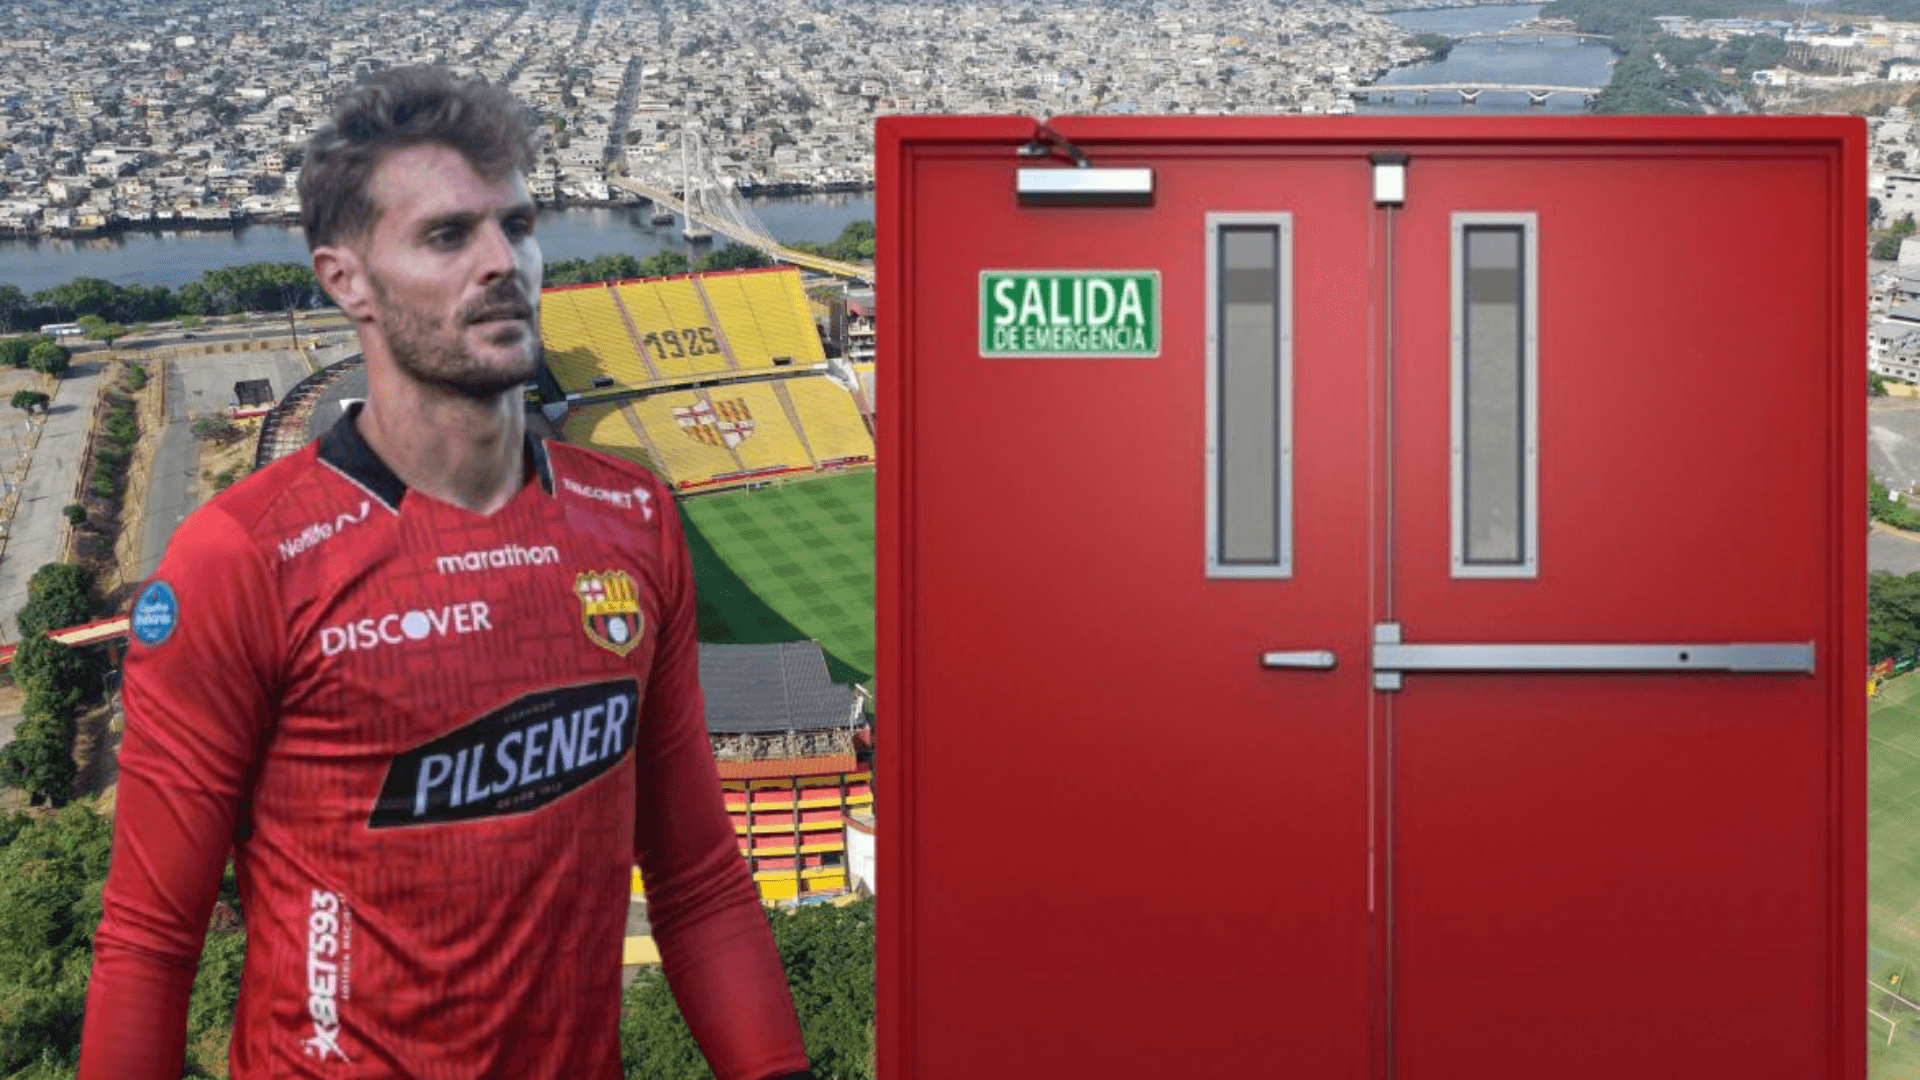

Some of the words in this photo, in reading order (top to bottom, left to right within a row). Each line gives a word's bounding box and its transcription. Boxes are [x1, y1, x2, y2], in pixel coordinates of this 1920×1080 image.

[994, 278, 1146, 326] SALIDA
[643, 326, 722, 369] 1925
[993, 326, 1018, 351] DE
[1024, 327, 1147, 351] EMERGENCIA
[436, 544, 560, 575] marathon
[320, 600, 492, 657] DISCOVER
[413, 694, 630, 817] PILSENER
